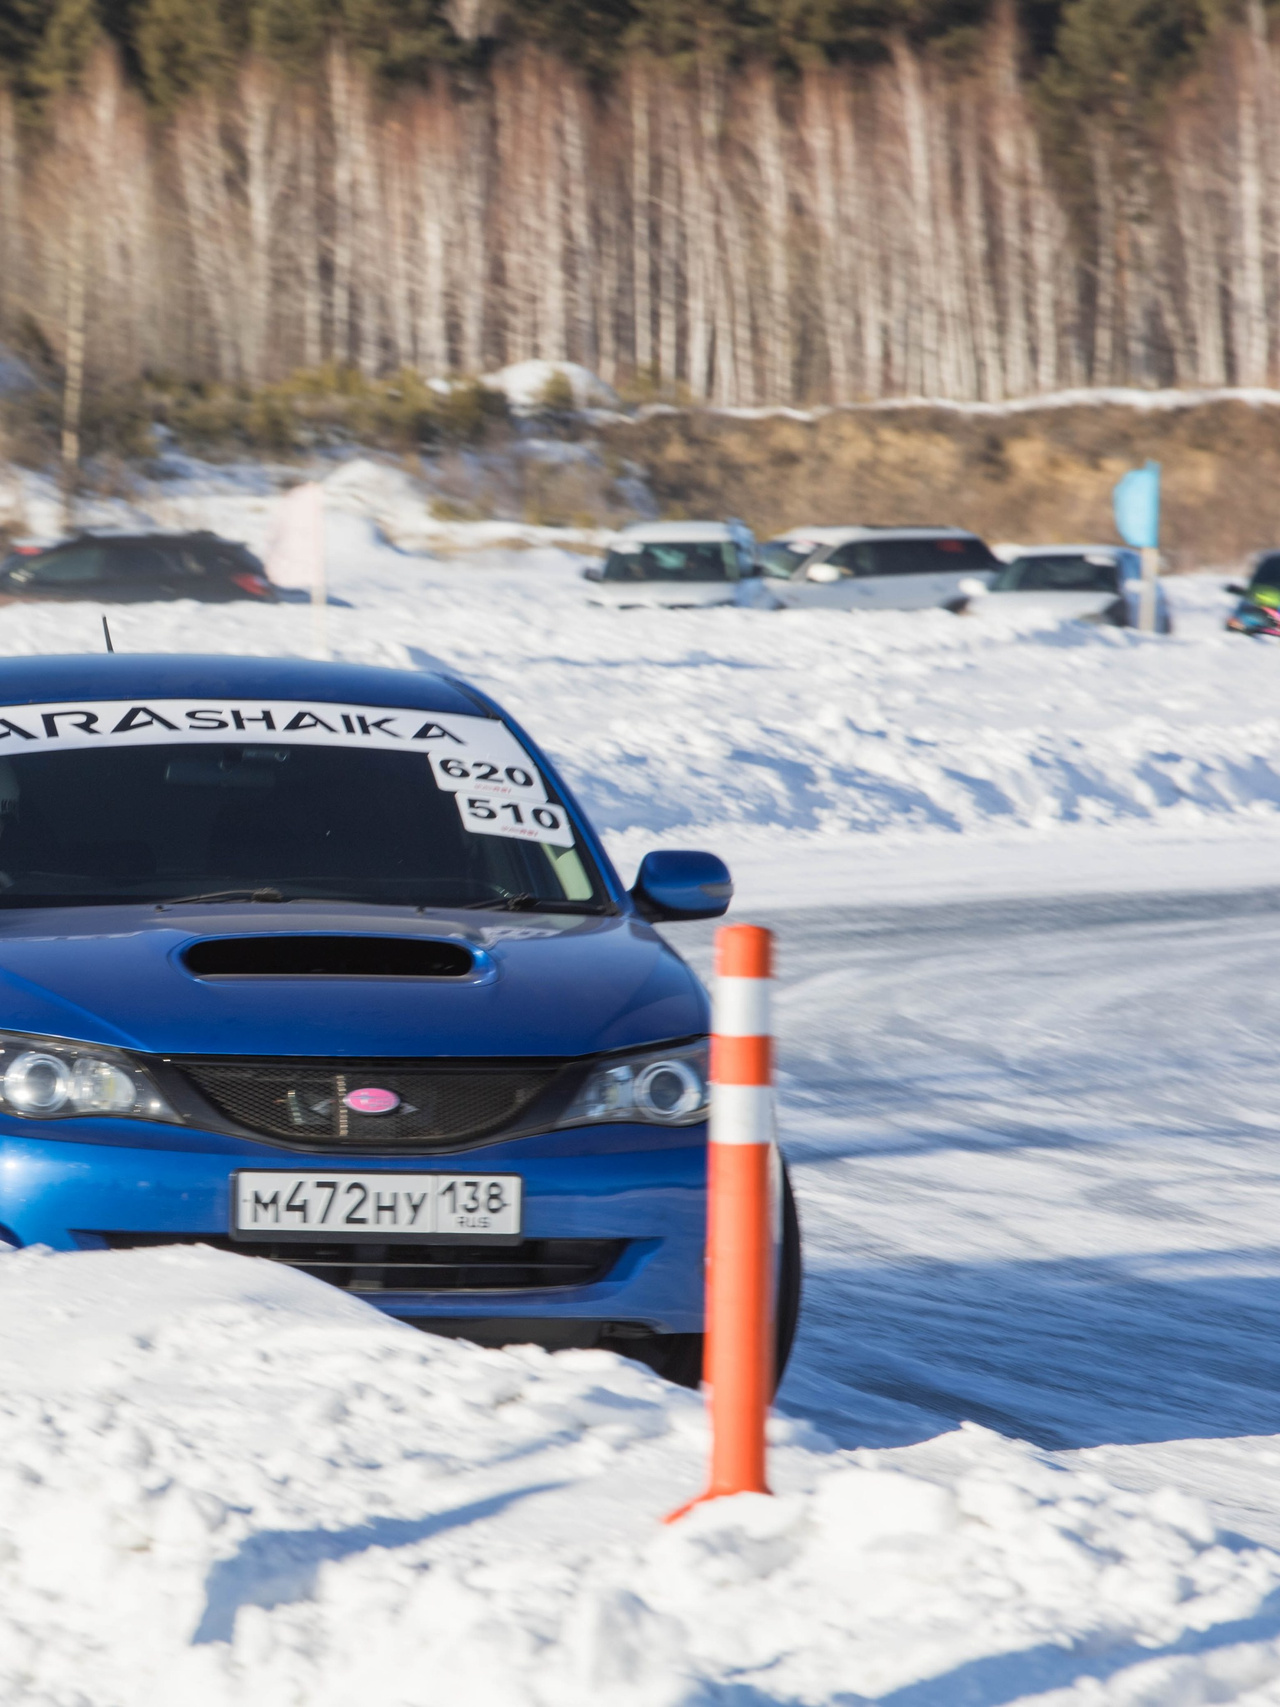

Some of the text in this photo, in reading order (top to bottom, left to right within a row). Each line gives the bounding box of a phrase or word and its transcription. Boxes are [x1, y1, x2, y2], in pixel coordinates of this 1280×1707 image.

[439, 758, 534, 787] 620
[468, 799, 560, 829] 510
[251, 1180, 505, 1225] М472НУ 138
[456, 1215, 491, 1228] RUS
